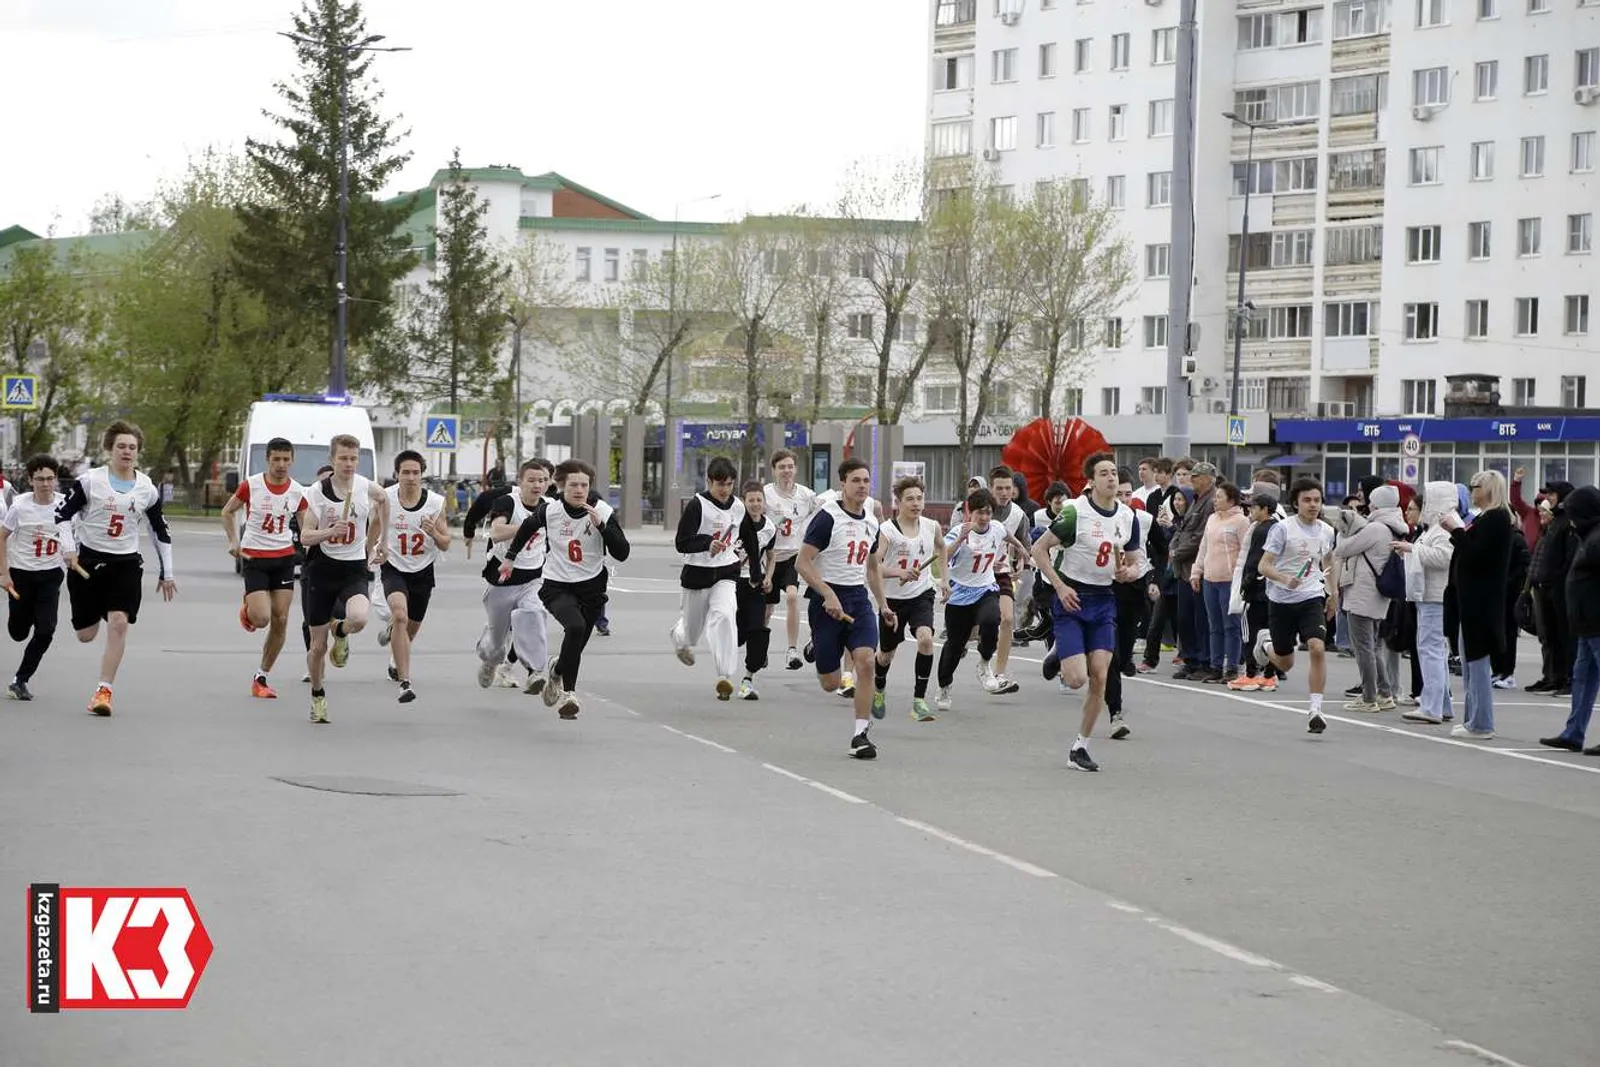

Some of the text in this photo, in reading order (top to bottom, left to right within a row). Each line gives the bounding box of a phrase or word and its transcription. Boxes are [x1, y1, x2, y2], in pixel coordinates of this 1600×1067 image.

[1364, 424, 1380, 436] ВТБ
[1499, 423, 1552, 435] ВТБ БАНК
[1406, 440, 1418, 451] 40
[107, 514, 125, 538] 5
[261, 513, 285, 534] 41
[781, 518, 793, 537] 3
[33, 538, 59, 558] 10
[397, 533, 425, 556] 12
[567, 539, 583, 563] 6
[846, 540, 870, 565] 16
[1095, 541, 1112, 568] 8
[971, 553, 995, 574] 17
